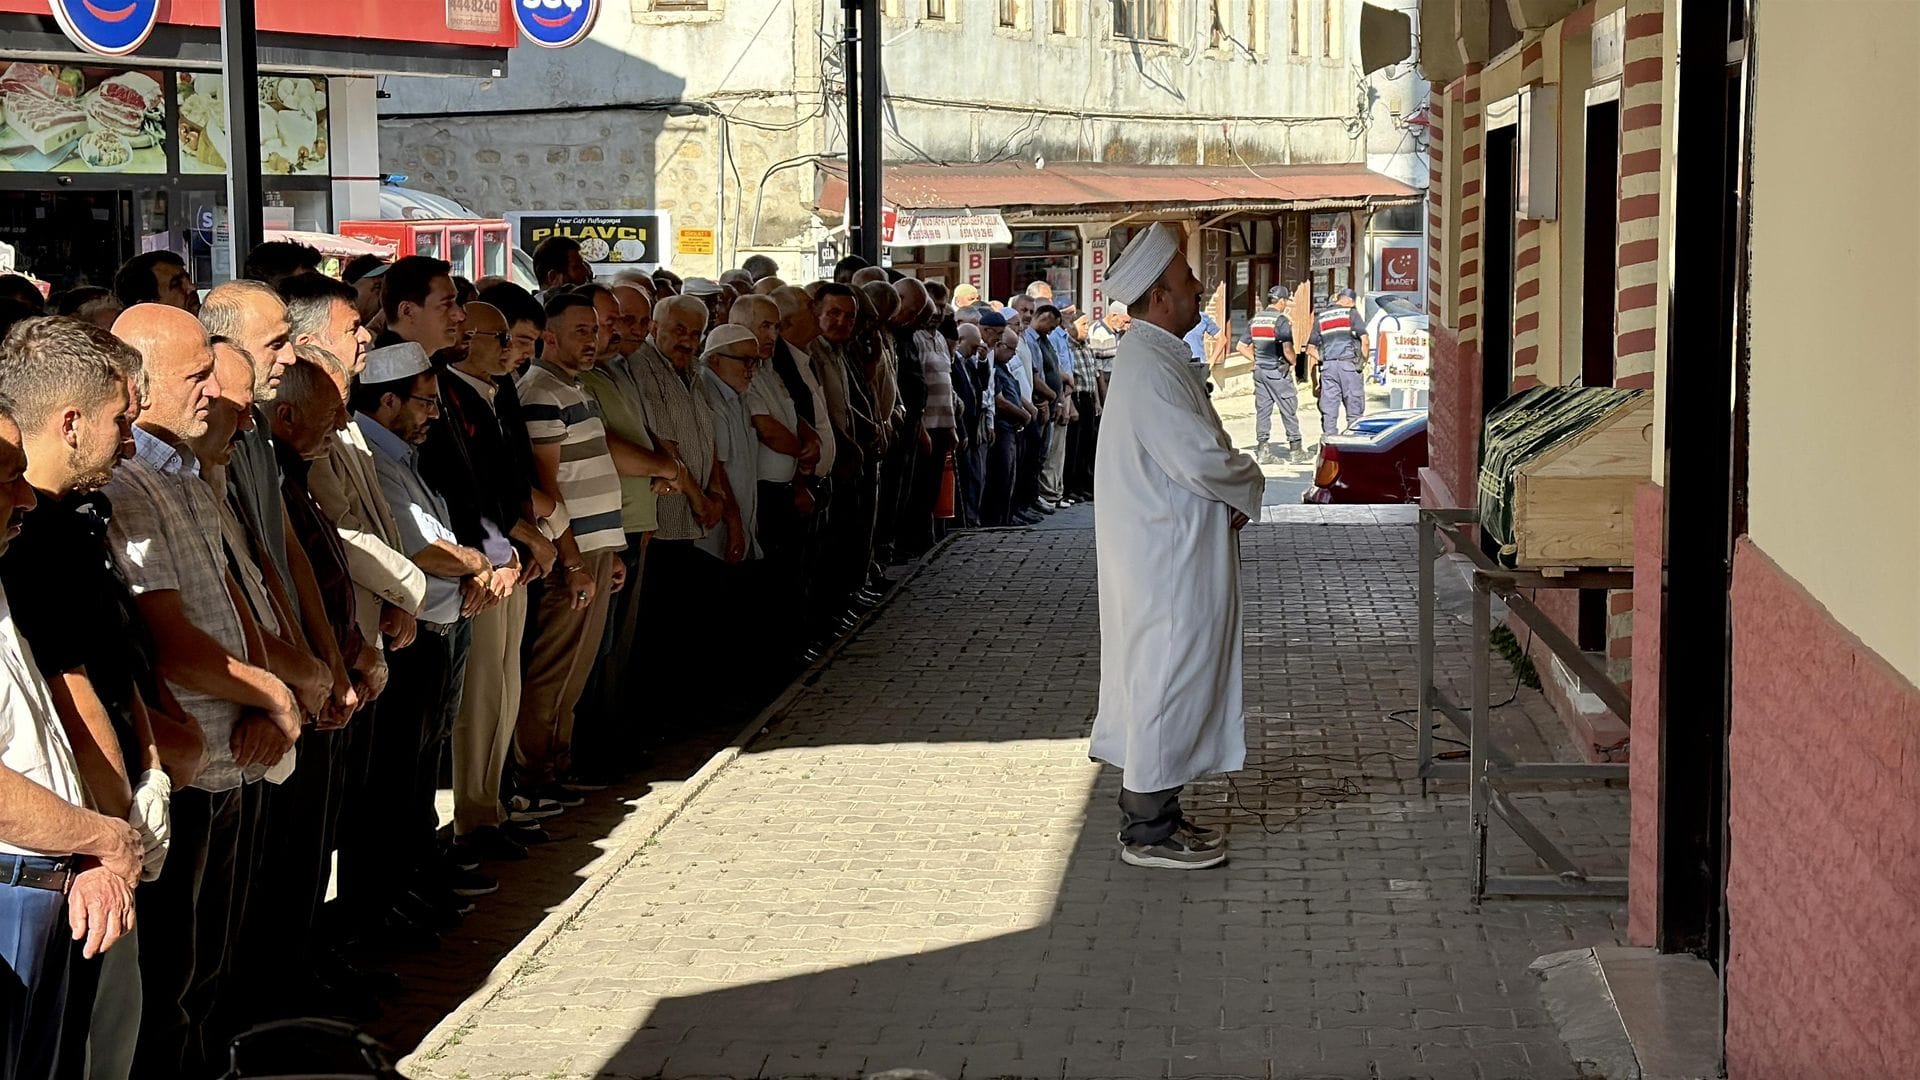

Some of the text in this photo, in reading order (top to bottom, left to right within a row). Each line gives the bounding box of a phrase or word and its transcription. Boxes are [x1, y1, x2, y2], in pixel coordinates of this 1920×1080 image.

[532, 223, 647, 241] PİLAVCI
[969, 253, 982, 289] BE
[1092, 251, 1104, 320] BERB
